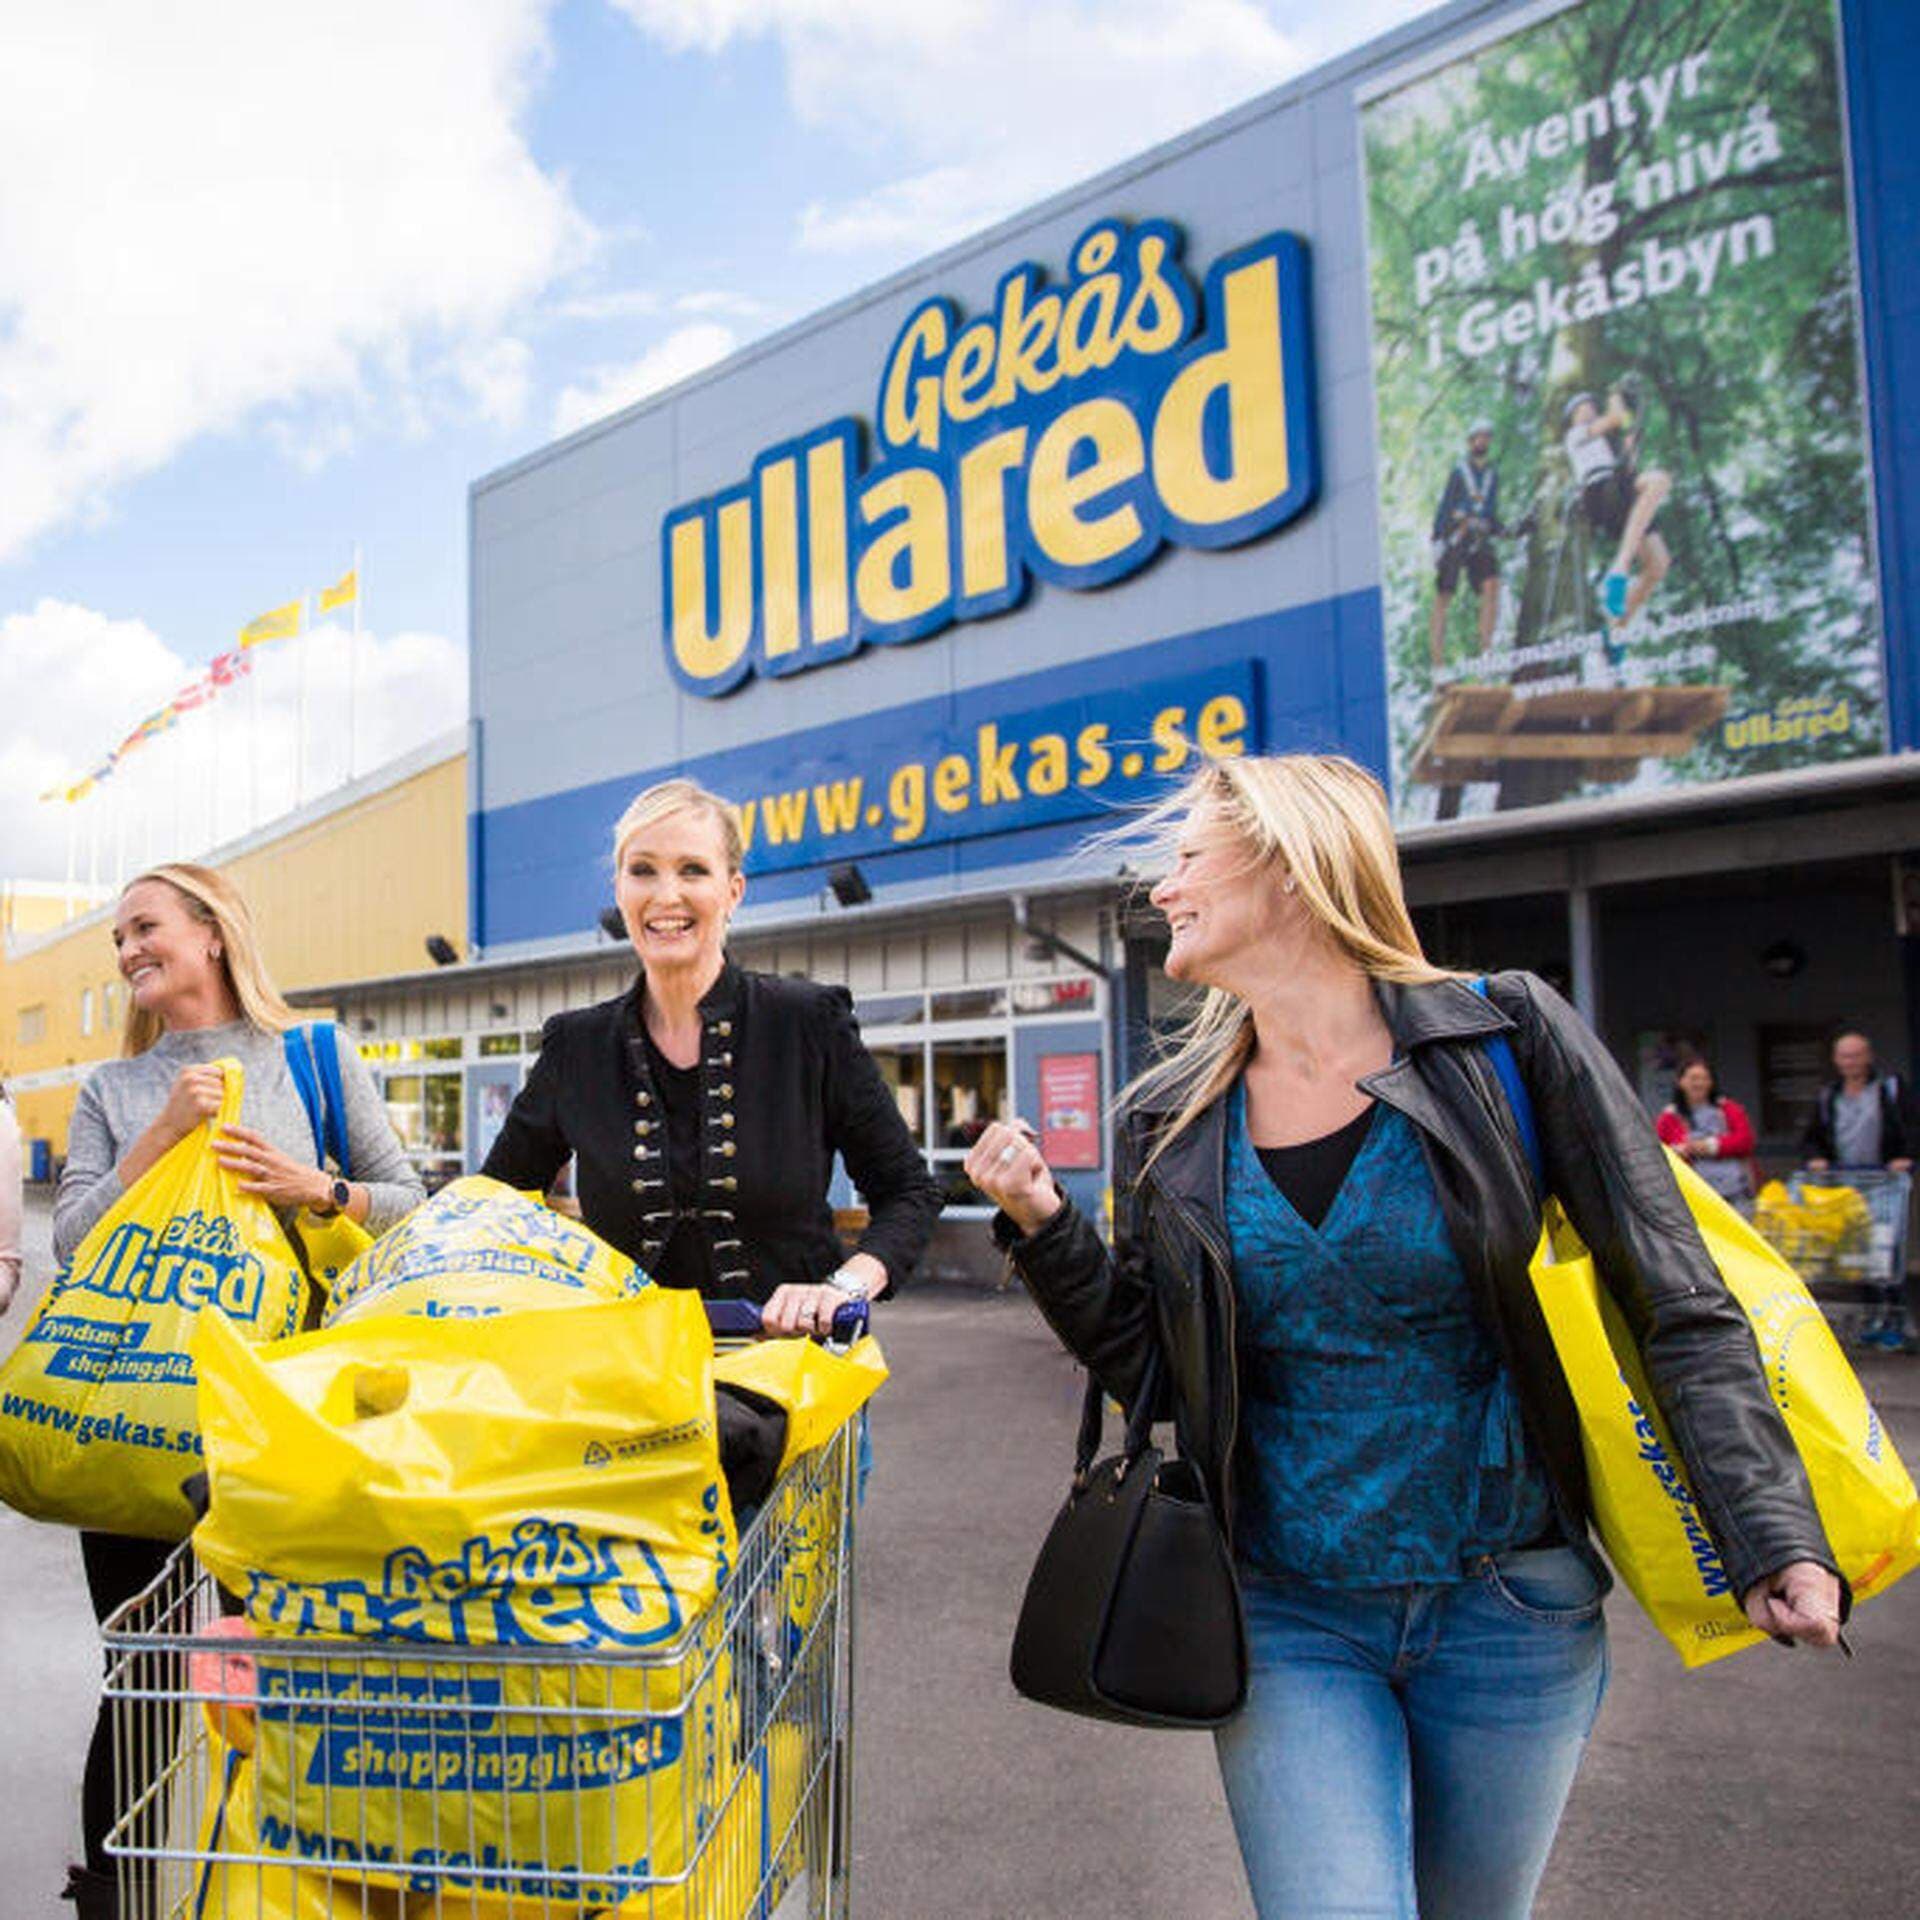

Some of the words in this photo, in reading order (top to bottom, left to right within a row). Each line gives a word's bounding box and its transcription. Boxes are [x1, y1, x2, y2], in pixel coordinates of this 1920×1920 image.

[1461, 51, 1711, 191] Äventyr
[1414, 219, 1487, 304] på
[1500, 178, 1620, 262] hög
[1634, 102, 1783, 210] nivå
[883, 229, 1183, 453] Gekås
[1427, 317, 1442, 367] i
[1456, 212, 1775, 357] Gekåsbyn
[671, 255, 1290, 679] Ullared
[1, 1392, 205, 1456] wwwgekas.s
[342, 1725, 663, 1789] shoppingglädje!
